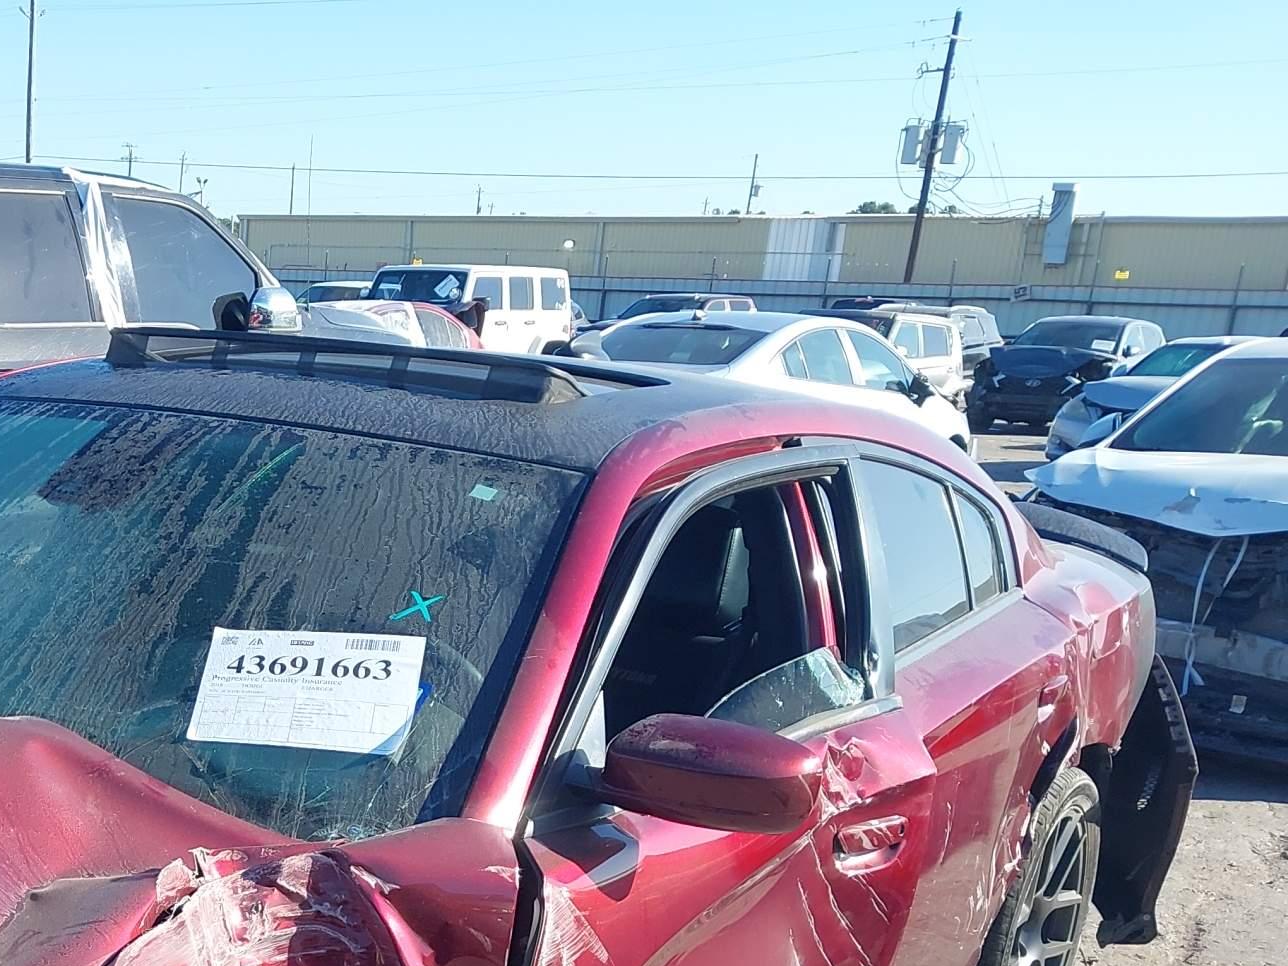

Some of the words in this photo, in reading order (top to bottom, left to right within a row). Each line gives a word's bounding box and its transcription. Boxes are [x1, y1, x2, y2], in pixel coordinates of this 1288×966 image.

[226, 654, 392, 681] 43691663
[212, 674, 261, 683] Progressive
[302, 677, 343, 687] Insurance
